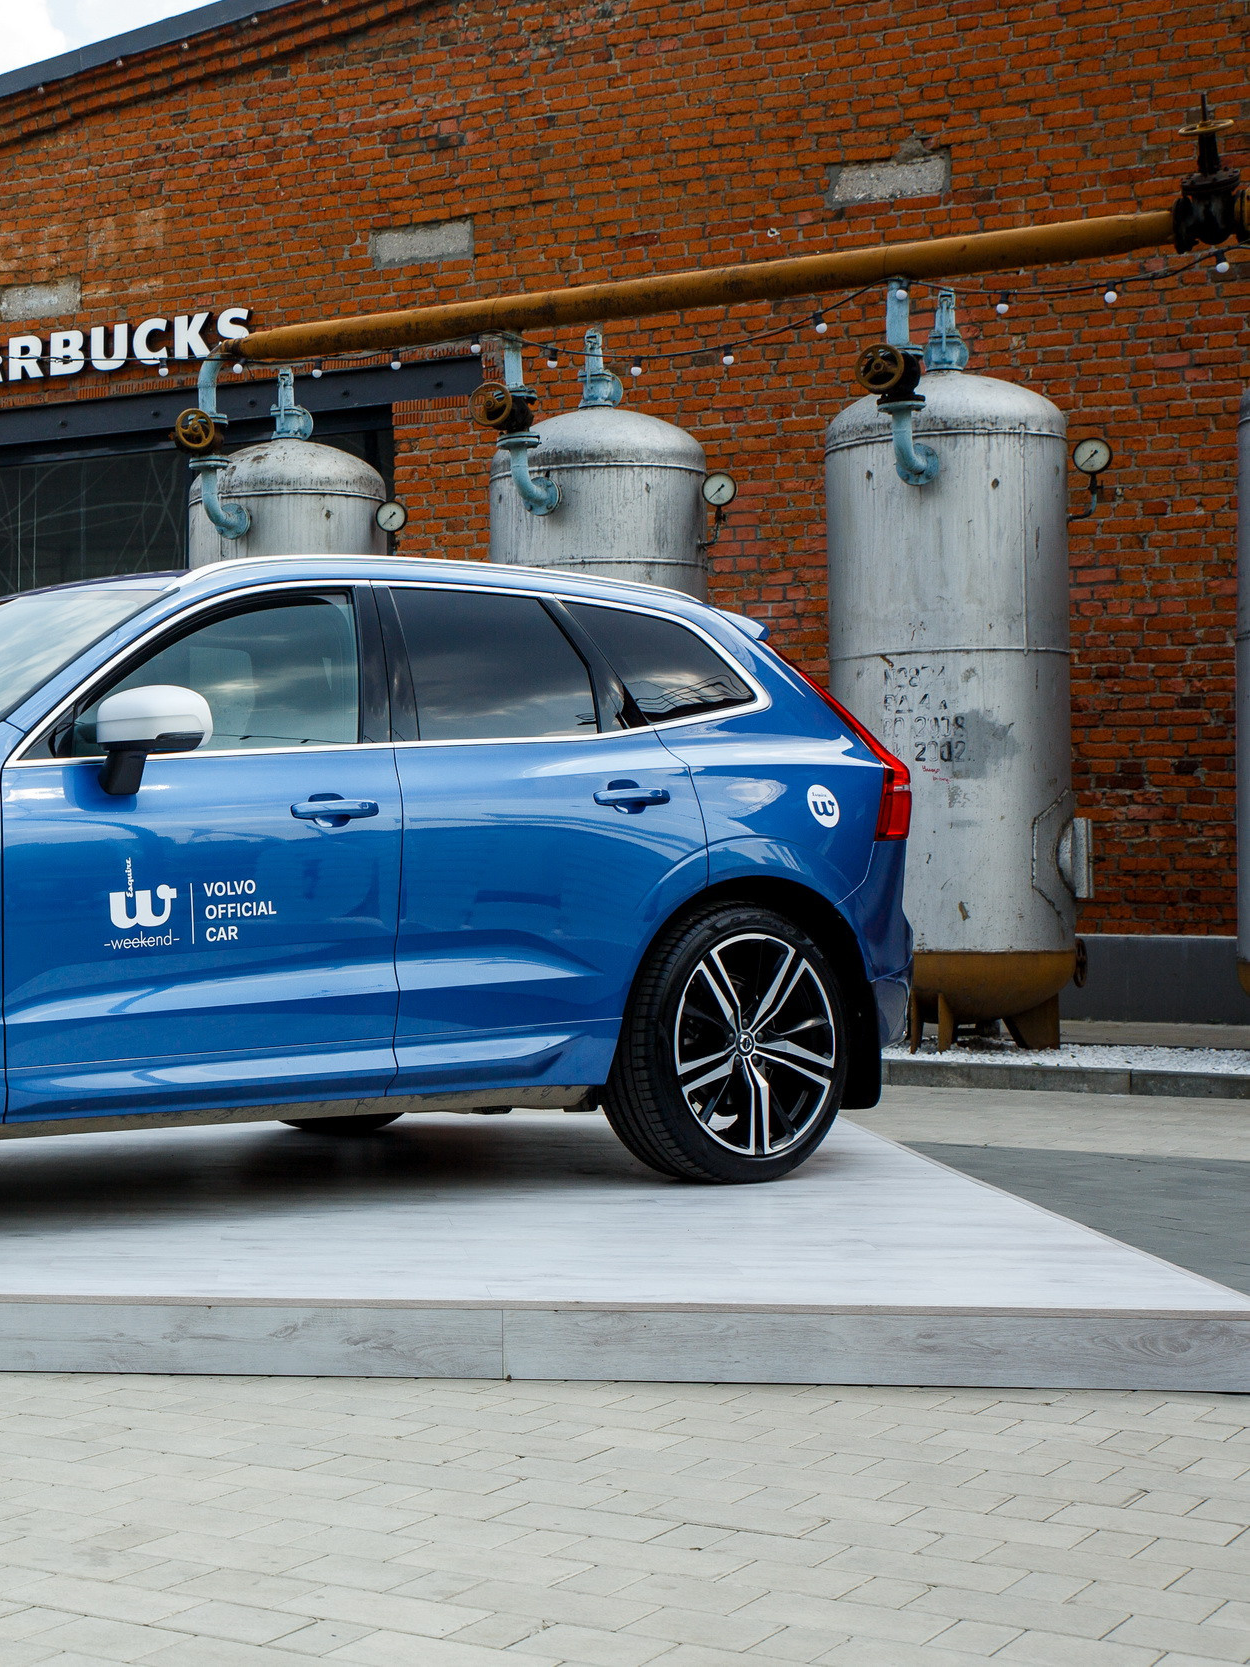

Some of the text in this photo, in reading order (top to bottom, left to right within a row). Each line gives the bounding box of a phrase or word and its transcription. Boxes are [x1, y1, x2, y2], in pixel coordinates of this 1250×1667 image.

[124, 856, 134, 898] Esquire
[203, 879, 256, 897] VOLVO
[204, 900, 277, 920] OFFICIAL
[205, 925, 239, 942] CAR
